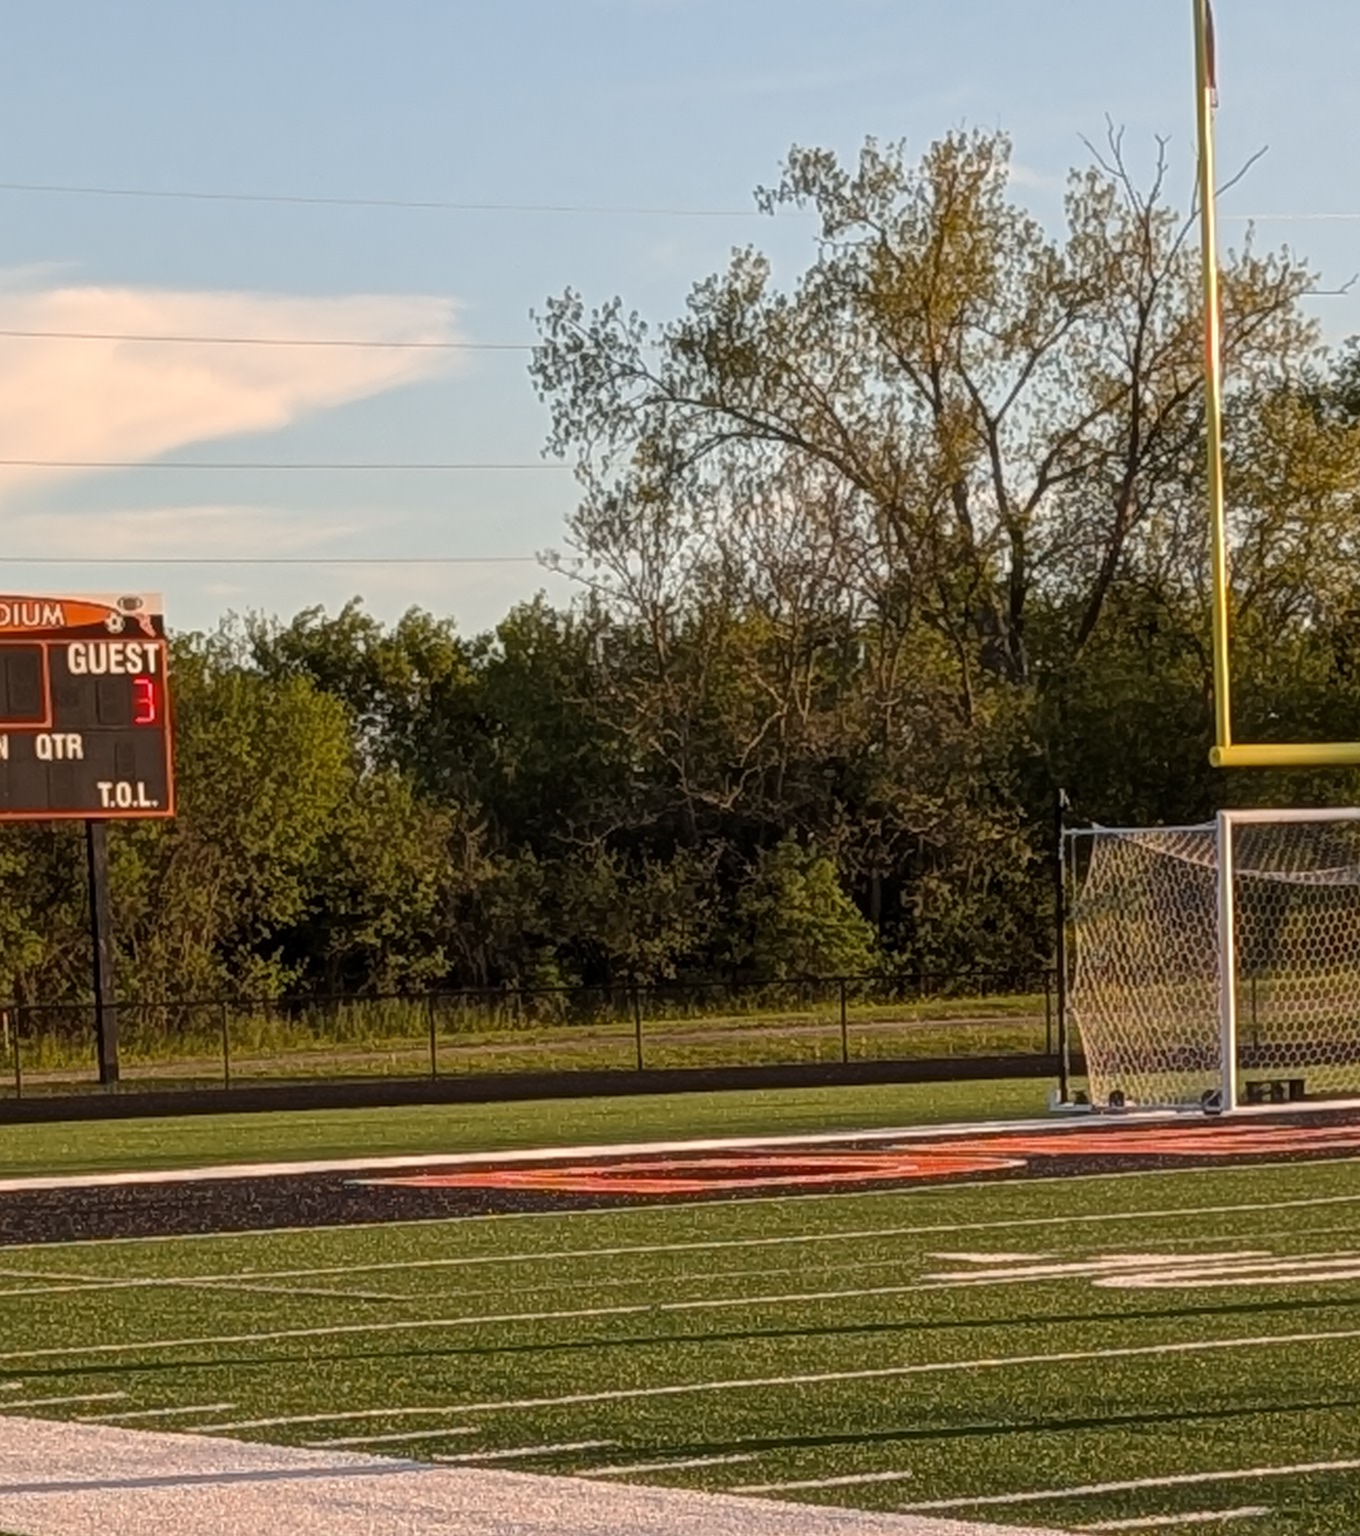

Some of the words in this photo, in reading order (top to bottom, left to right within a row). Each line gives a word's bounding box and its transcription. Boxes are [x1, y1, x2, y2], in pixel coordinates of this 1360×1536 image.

[68, 643, 159, 675] GUEST
[132, 677, 155, 724] 3
[35, 733, 83, 761] QTR
[97, 781, 158, 808] T.O.L.
